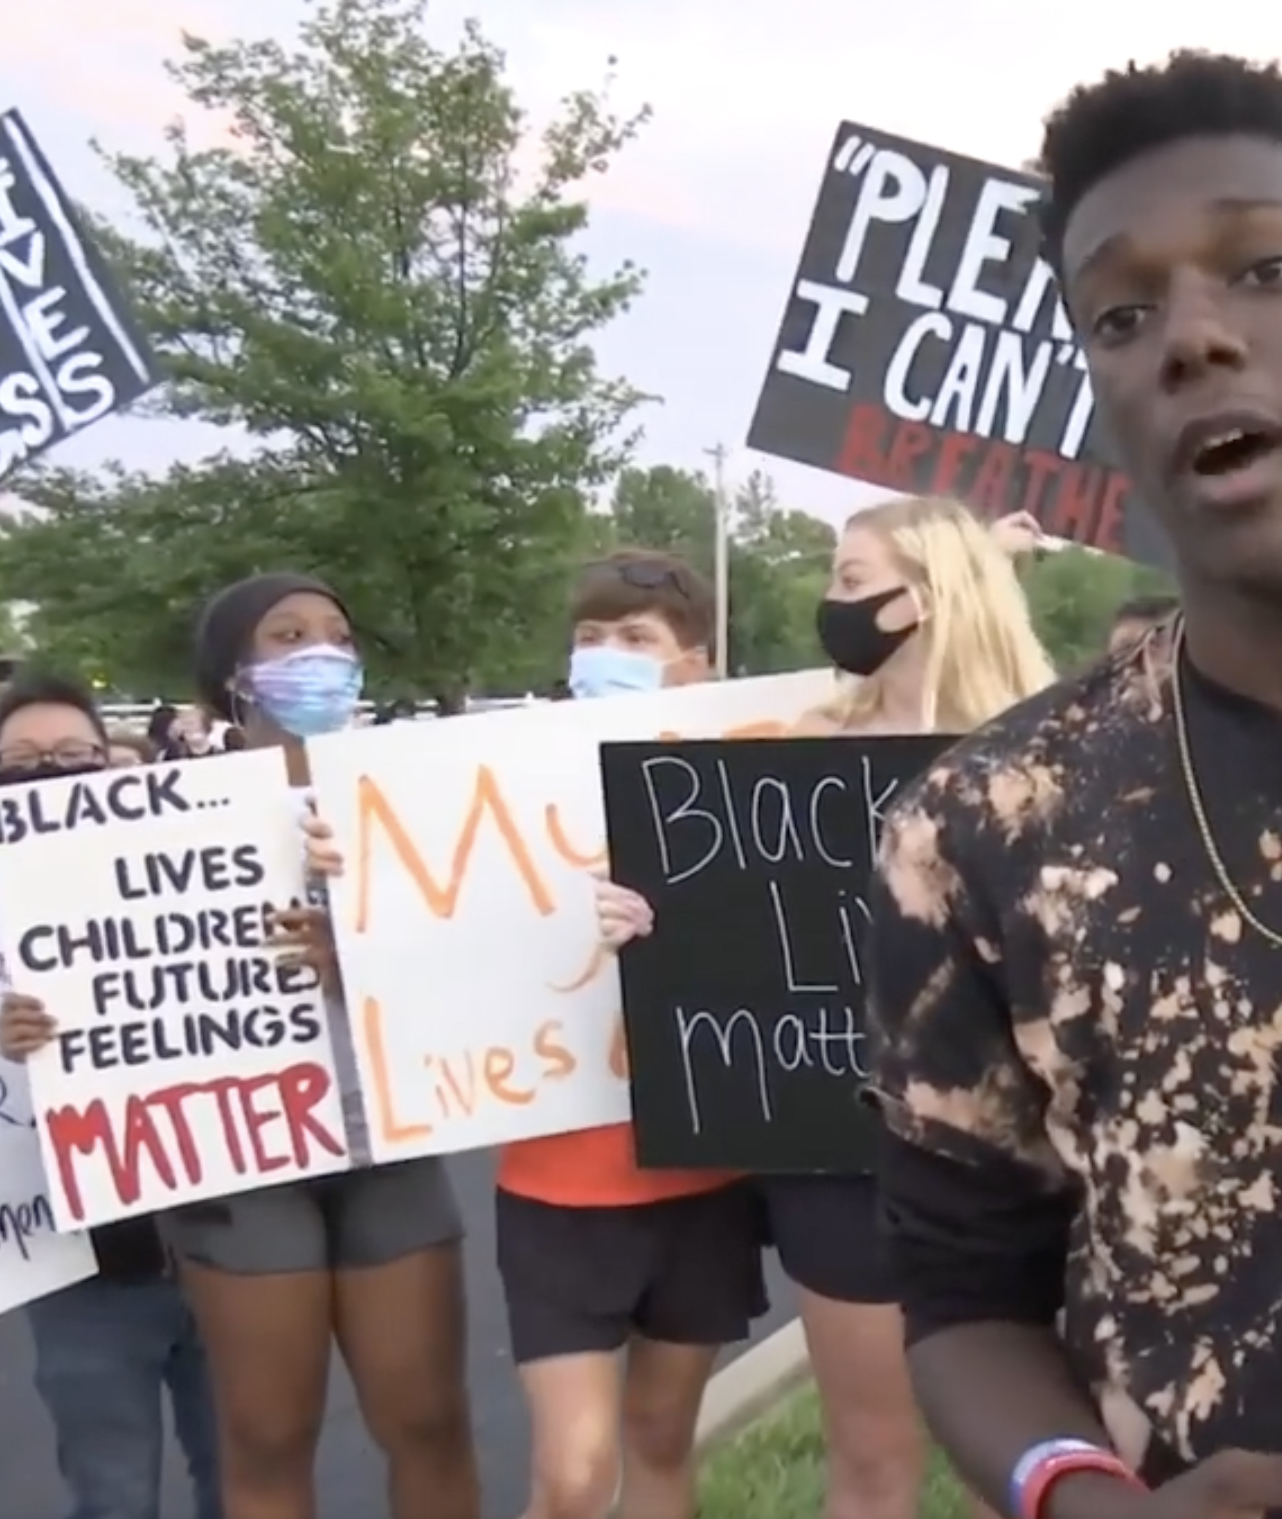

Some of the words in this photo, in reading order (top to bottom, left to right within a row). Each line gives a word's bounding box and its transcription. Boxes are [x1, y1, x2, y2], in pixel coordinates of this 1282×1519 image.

[777, 280, 869, 391] I
[883, 311, 1095, 460] CAN'T
[115, 845, 265, 900] LIVES
[642, 755, 899, 884] Black
[770, 880, 874, 992] Li
[59, 1003, 321, 1073] FEELINGS
[363, 995, 577, 1142] Lives
[45, 1061, 347, 1221] MATTER
